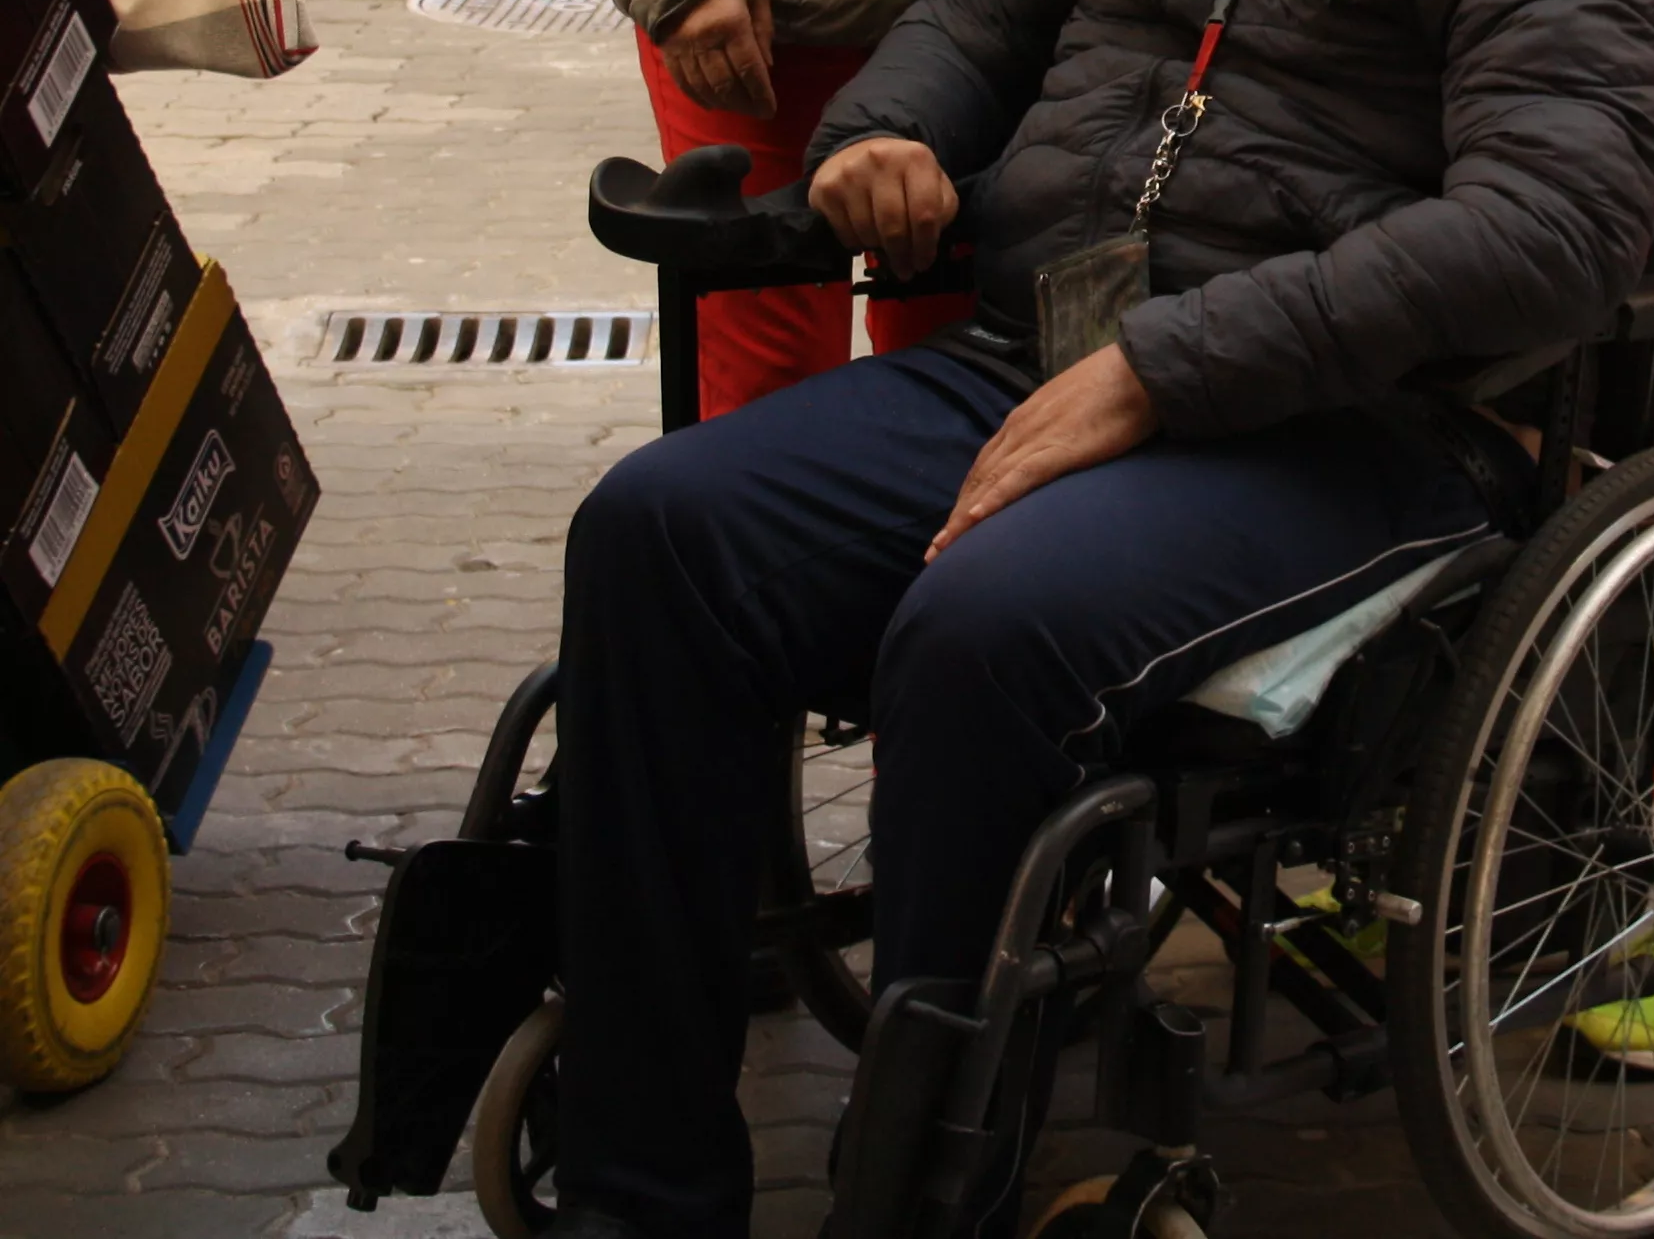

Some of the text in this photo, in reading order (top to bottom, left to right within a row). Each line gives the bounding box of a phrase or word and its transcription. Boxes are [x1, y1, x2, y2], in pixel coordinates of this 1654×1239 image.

[173, 448, 222, 545] Kaiku
[206, 518, 275, 656] BARISTA
[92, 598, 146, 700] MEJORES
[110, 627, 163, 725] SABOR
